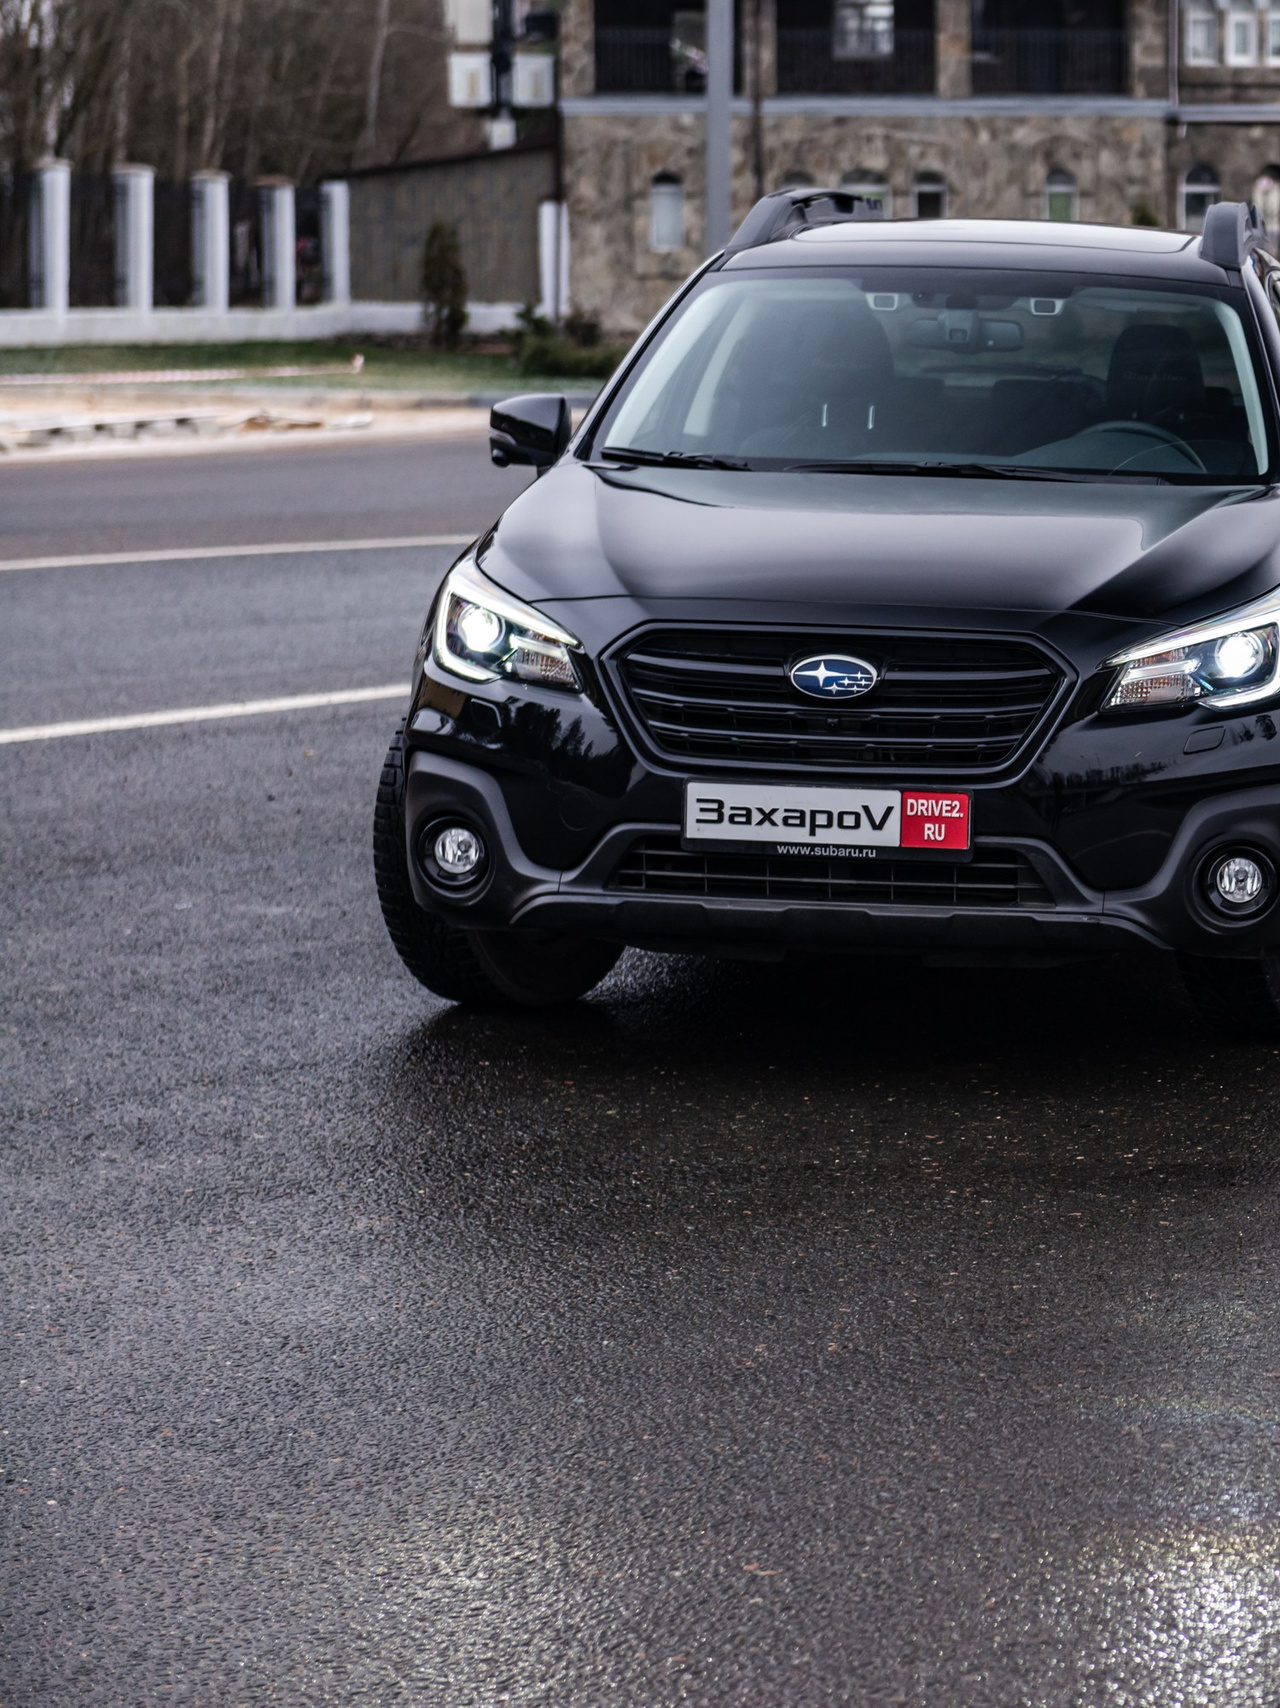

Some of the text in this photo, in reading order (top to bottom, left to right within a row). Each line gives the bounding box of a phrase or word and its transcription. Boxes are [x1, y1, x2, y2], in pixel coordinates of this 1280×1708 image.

[906, 799, 964, 818] DRIVE2.
[924, 823, 946, 841] RU
[777, 843, 876, 858] www.subaru.ru
